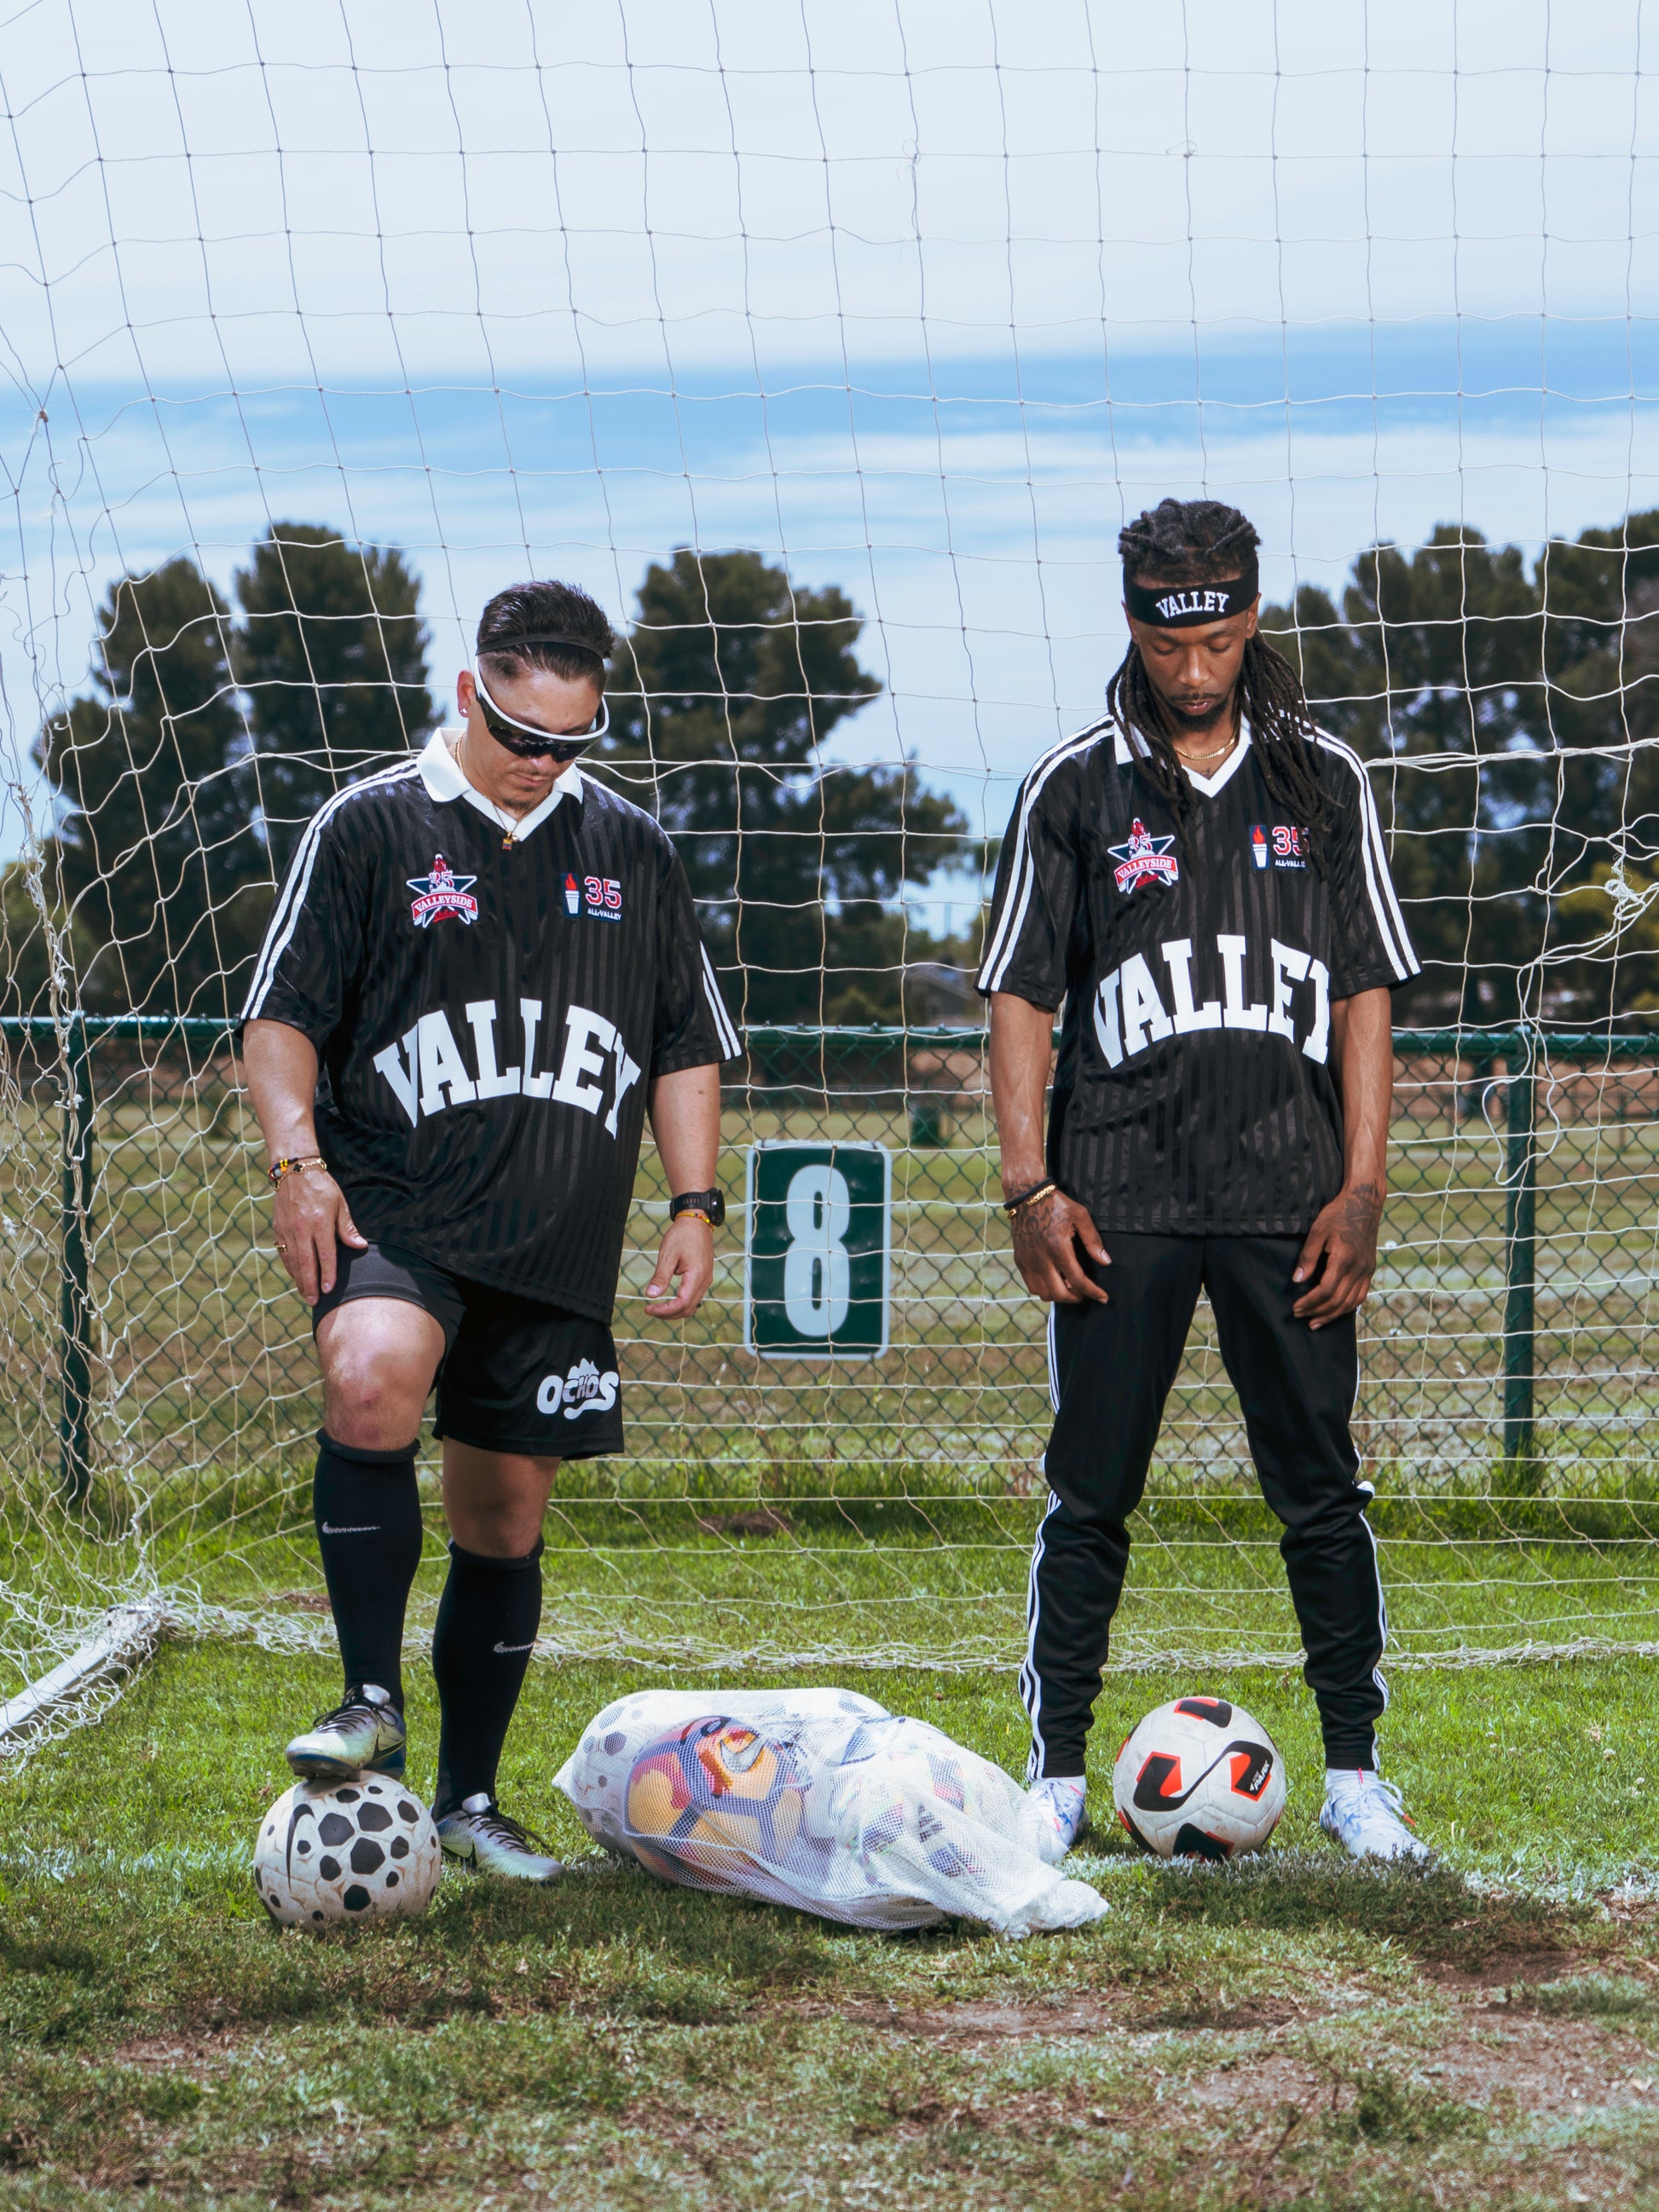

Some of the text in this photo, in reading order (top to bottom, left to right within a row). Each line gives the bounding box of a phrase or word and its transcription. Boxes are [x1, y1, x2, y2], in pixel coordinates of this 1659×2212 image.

[1155, 591, 1229, 619] VALLEY
[1128, 833, 1153, 857] 35
[1117, 858, 1172, 879] VALLEYSIDE
[1275, 859, 1305, 868] ALL-VALLE
[429, 870, 454, 892] 35
[584, 875, 621, 910] 35
[413, 895, 473, 912] VALLEYSIDE
[587, 908, 622, 921] ALL-VALLEY
[373, 997, 641, 1141] VALLEY
[783, 1164, 851, 1337] 8
